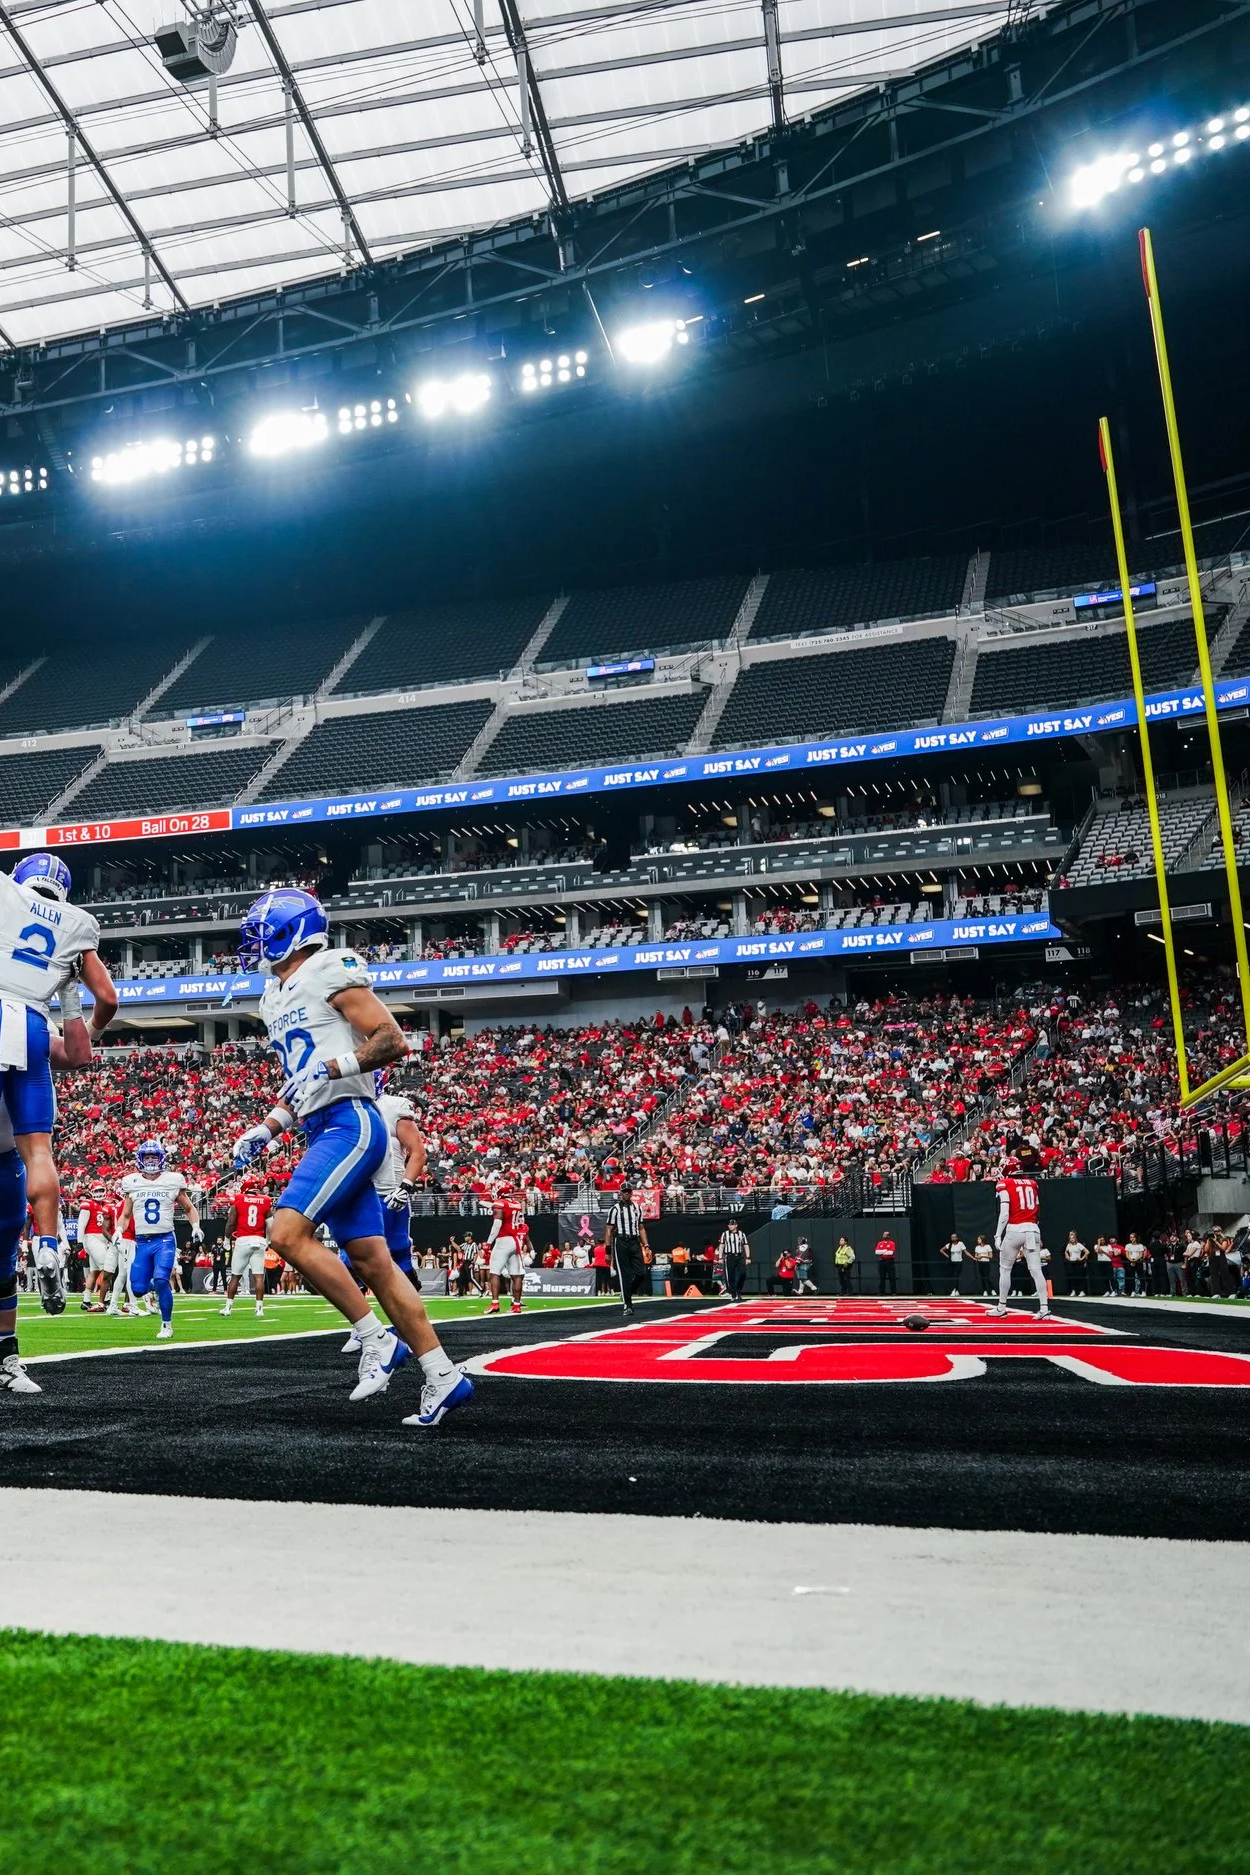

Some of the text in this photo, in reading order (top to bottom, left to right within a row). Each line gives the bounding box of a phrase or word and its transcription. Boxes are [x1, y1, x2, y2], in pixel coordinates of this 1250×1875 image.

[398, 694, 416, 704] 414
[1144, 700, 1179, 717] JUST
[1027, 721, 1060, 736] JUST
[1064, 715, 1092, 730] SAY
[21, 739, 37, 748] 412
[914, 735, 947, 749] JUST
[949, 731, 977, 744] SAY
[807, 748, 838, 763] JUST
[840, 745, 867, 758] SAY
[703, 760, 734, 775] JUST
[735, 758, 761, 771] SAY
[604, 773, 633, 786] JUST
[635, 769, 659, 782] SAY
[508, 784, 536, 797] JUST
[538, 781, 562, 793] SAY
[416, 794, 443, 807] JUST
[444, 791, 468, 803] SAY
[327, 804, 353, 816] JUST
[354, 801, 377, 813] SAY
[240, 810, 288, 825] JUST SAY
[58, 817, 210, 843] 1st & 10 Ball On 28
[30, 902, 63, 926] ALLEN
[952, 926, 986, 940] JUST
[988, 922, 1017, 935] SAY
[12, 921, 57, 971] 2
[842, 935, 874, 948] JUST
[876, 932, 903, 944] SAY
[634, 951, 665, 964] JUST
[666, 949, 691, 961] SAY
[736, 944, 767, 956] JUST
[769, 941, 795, 954] SAY
[443, 965, 471, 977] JUST
[472, 963, 496, 975] SAY
[537, 958, 566, 971] JUST
[567, 956, 592, 969] SAY
[381, 970, 403, 982] SAY
[122, 986, 143, 998] SAY
[179, 981, 227, 994] JUST SAY
[273, 1006, 309, 1032] FORCE
[146, 1190, 170, 1199] FORCE
[1016, 1186, 1035, 1210] 10
[144, 1198, 161, 1225] 8
[247, 1204, 258, 1227] 8
[479, 1207, 494, 1216] 116
[729, 1203, 745, 1212] 117
[522, 1284, 592, 1294] tar Nursery
